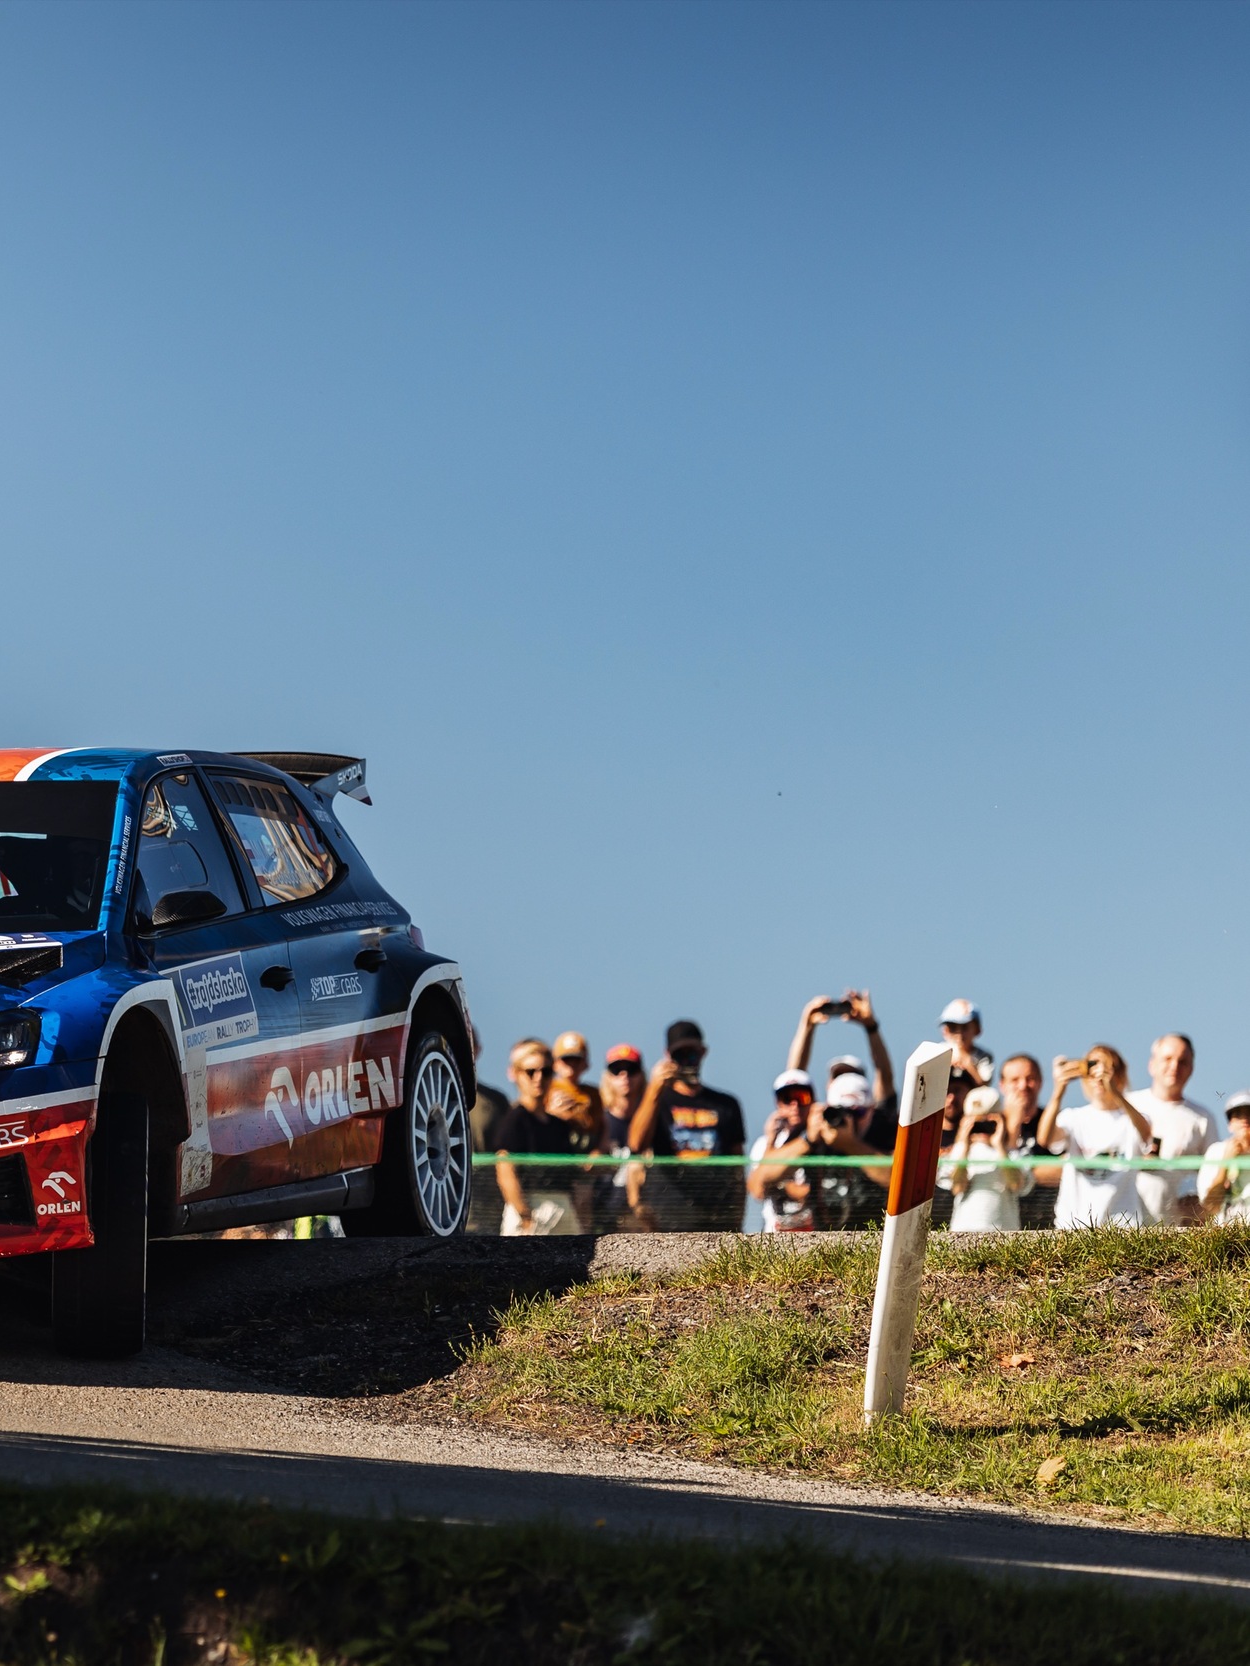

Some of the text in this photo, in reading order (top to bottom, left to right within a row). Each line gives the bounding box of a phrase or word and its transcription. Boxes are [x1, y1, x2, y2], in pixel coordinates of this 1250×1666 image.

[114, 815, 132, 895] VOLKSWAGEN FINANCIAL SERVICES
[280, 904, 334, 927] VOLKSWAGEN
[187, 968, 247, 1012] #rajdslaska
[341, 976, 363, 994] CARS
[216, 1023, 234, 1040] RALLY
[235, 1016, 257, 1034] TROPHY
[304, 1056, 396, 1125] ORLEN
[37, 1200, 81, 1215] ORLEN
